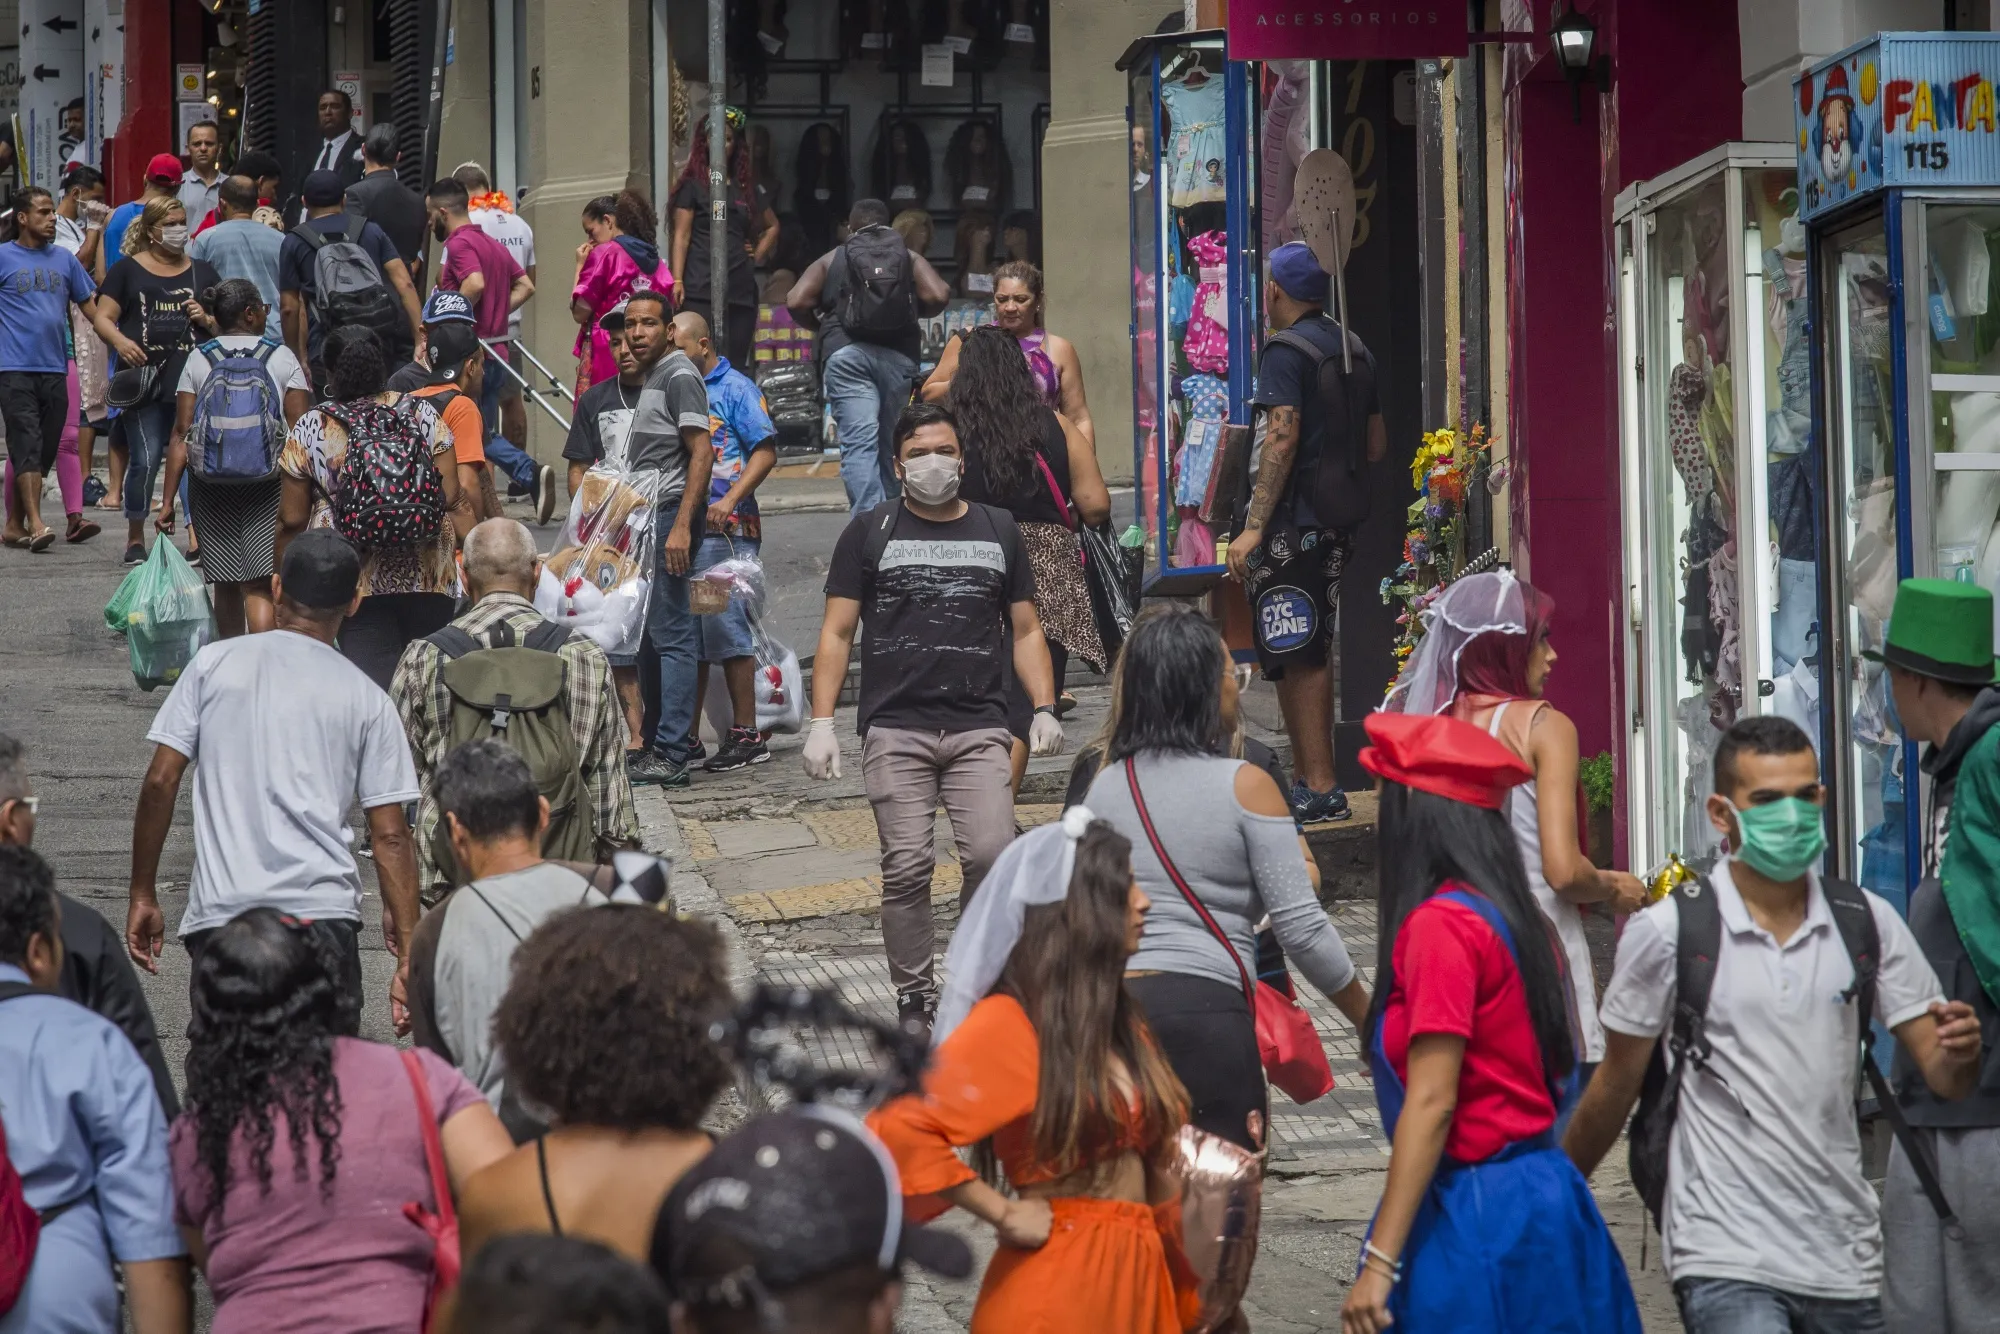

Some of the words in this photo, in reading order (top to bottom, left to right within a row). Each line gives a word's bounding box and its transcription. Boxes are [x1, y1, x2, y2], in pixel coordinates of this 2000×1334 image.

[1256, 12, 1438, 26] ACESSORIOS
[531, 65, 540, 100] 85
[1903, 142, 1950, 171] 115
[1805, 178, 1820, 211] 115
[17, 267, 62, 294] GAP
[928, 544, 968, 560] Klein
[1262, 601, 1293, 622] CYC
[1264, 616, 1309, 641] LONE
